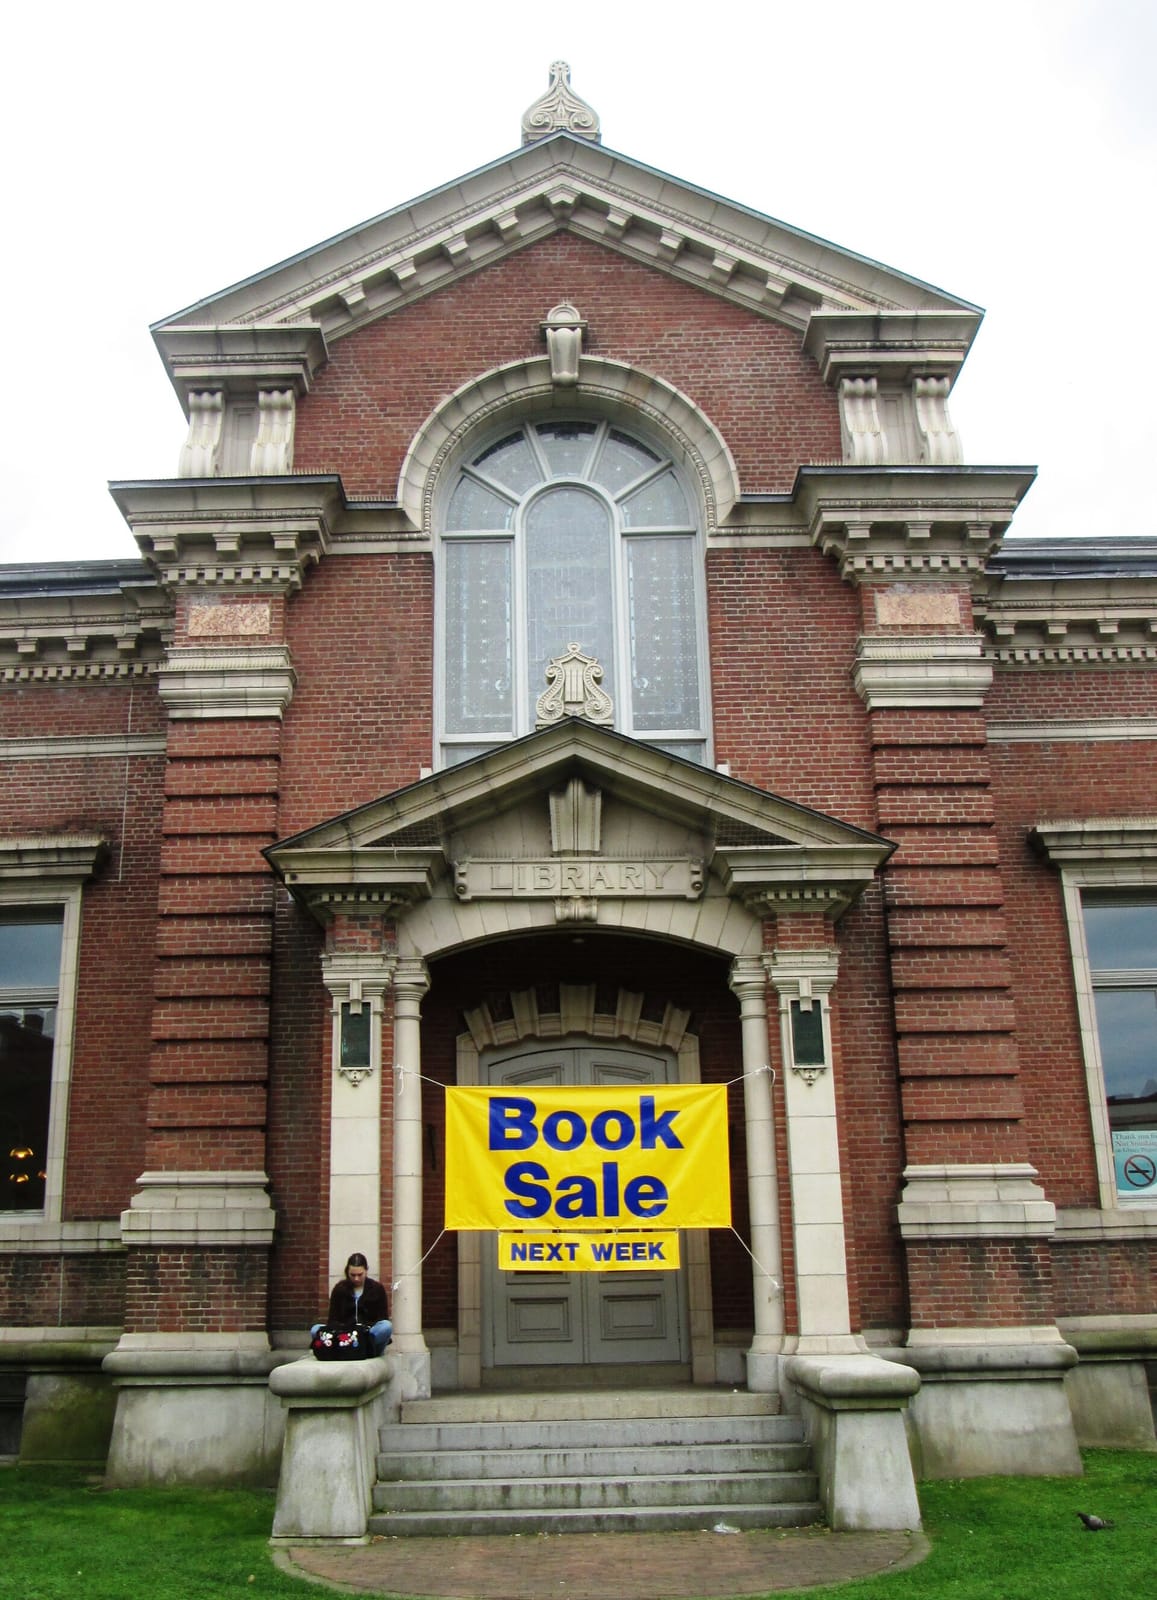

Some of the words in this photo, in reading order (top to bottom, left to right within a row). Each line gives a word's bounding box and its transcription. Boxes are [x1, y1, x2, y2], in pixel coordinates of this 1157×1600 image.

[490, 865, 673, 890] LIBRARY
[489, 1096, 685, 1151] Book
[504, 1161, 669, 1219] Sale
[511, 1242, 580, 1262] NEXT
[591, 1241, 666, 1261] WEEK
